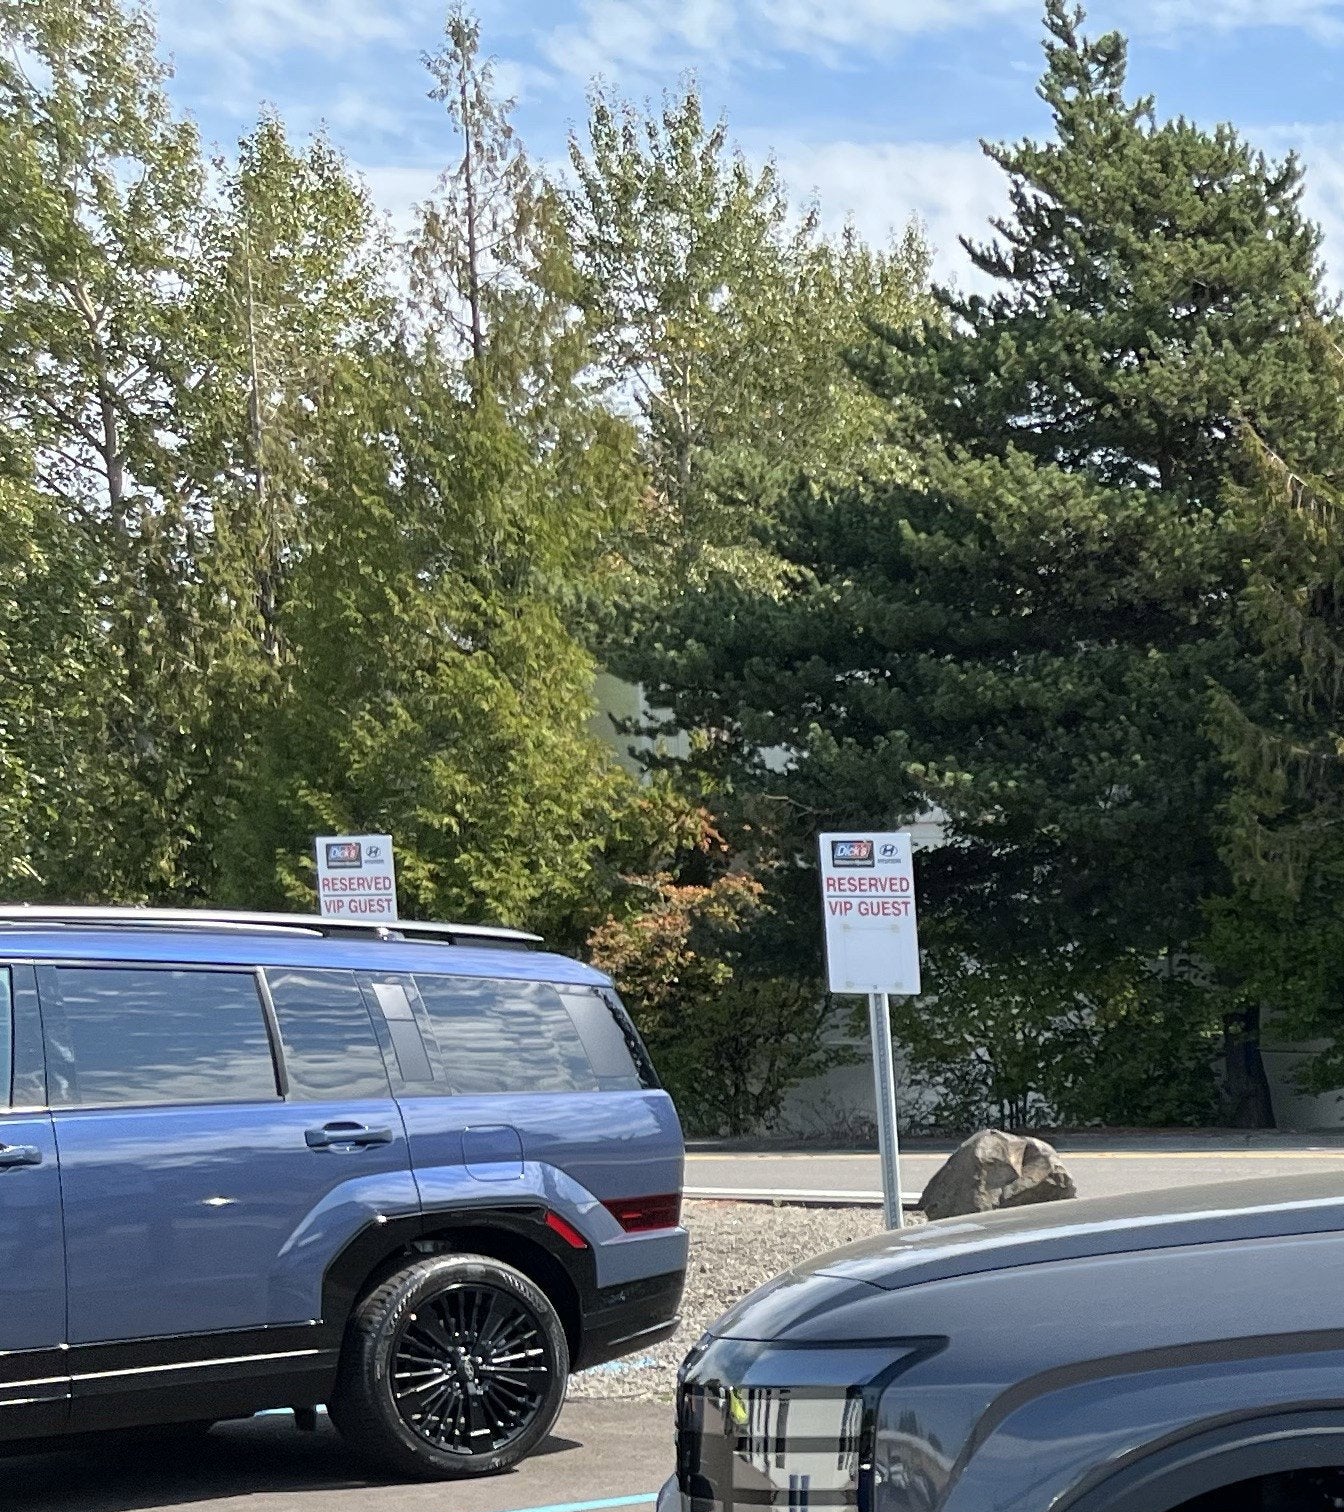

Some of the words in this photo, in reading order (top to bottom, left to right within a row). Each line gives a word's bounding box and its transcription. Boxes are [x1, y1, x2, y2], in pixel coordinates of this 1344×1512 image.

[322, 876, 392, 892] RESERVED
[826, 877, 910, 893] RESERVED
[324, 899, 344, 913] VIP
[348, 898, 393, 913] GUEST
[828, 901, 853, 916] VIP
[858, 901, 911, 917] GUEST
